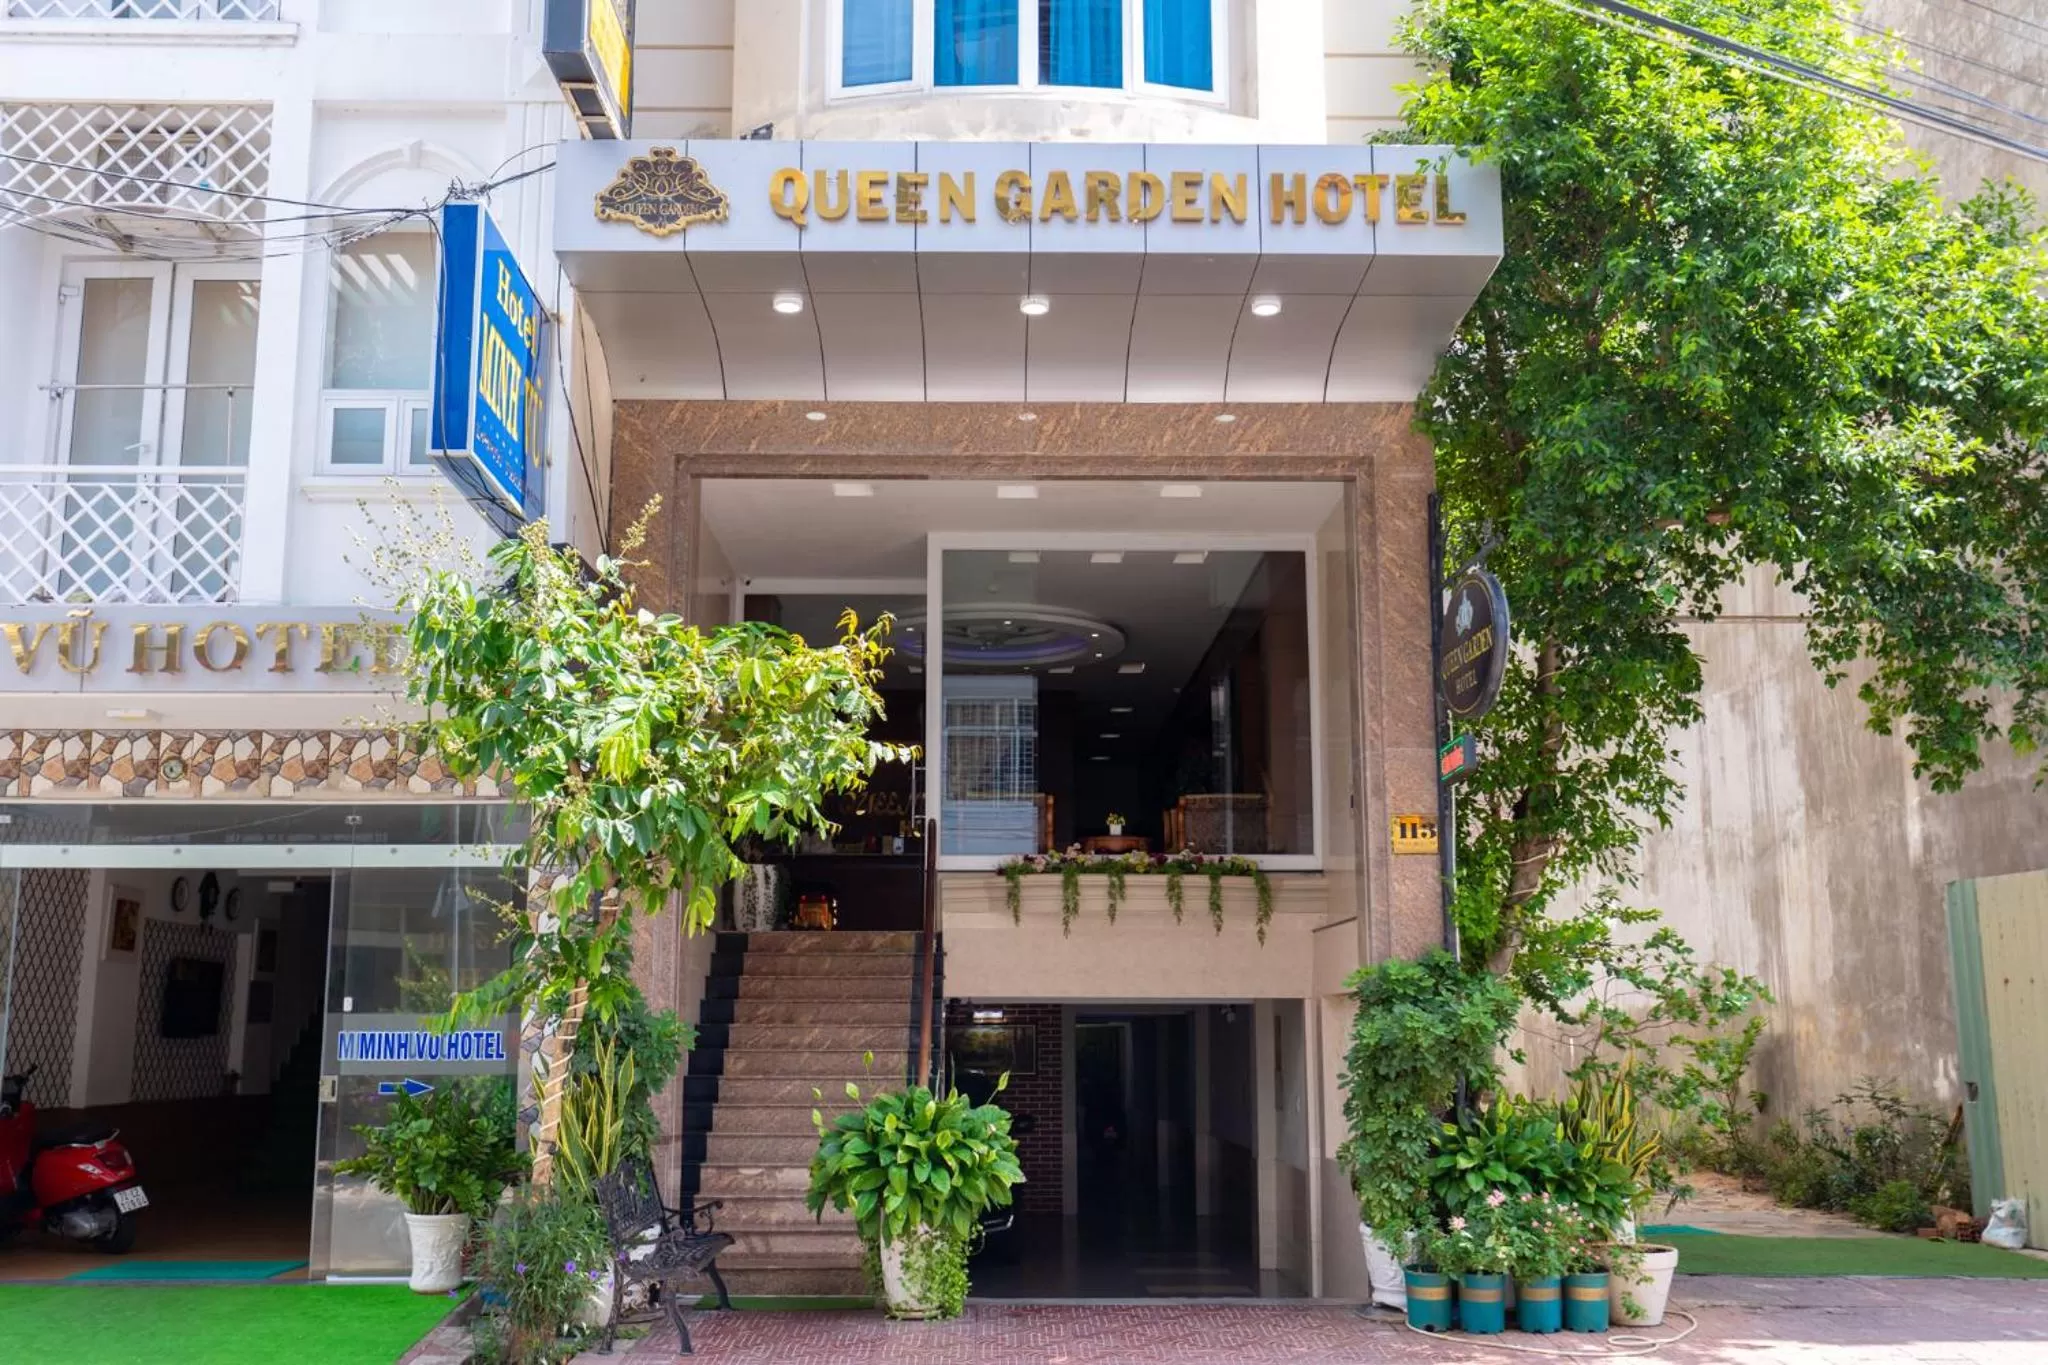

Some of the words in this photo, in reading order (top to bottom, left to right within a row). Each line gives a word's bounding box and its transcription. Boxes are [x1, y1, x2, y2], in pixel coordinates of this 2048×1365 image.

[768, 167, 977, 230] QUEEN
[994, 169, 1248, 226] GARDEN
[1269, 171, 1468, 226] HOTEL
[496, 257, 537, 357] Hotel
[479, 311, 522, 442] MINH
[126, 620, 402, 675] HOTEL
[446, 1032, 506, 1060] HOTEL
